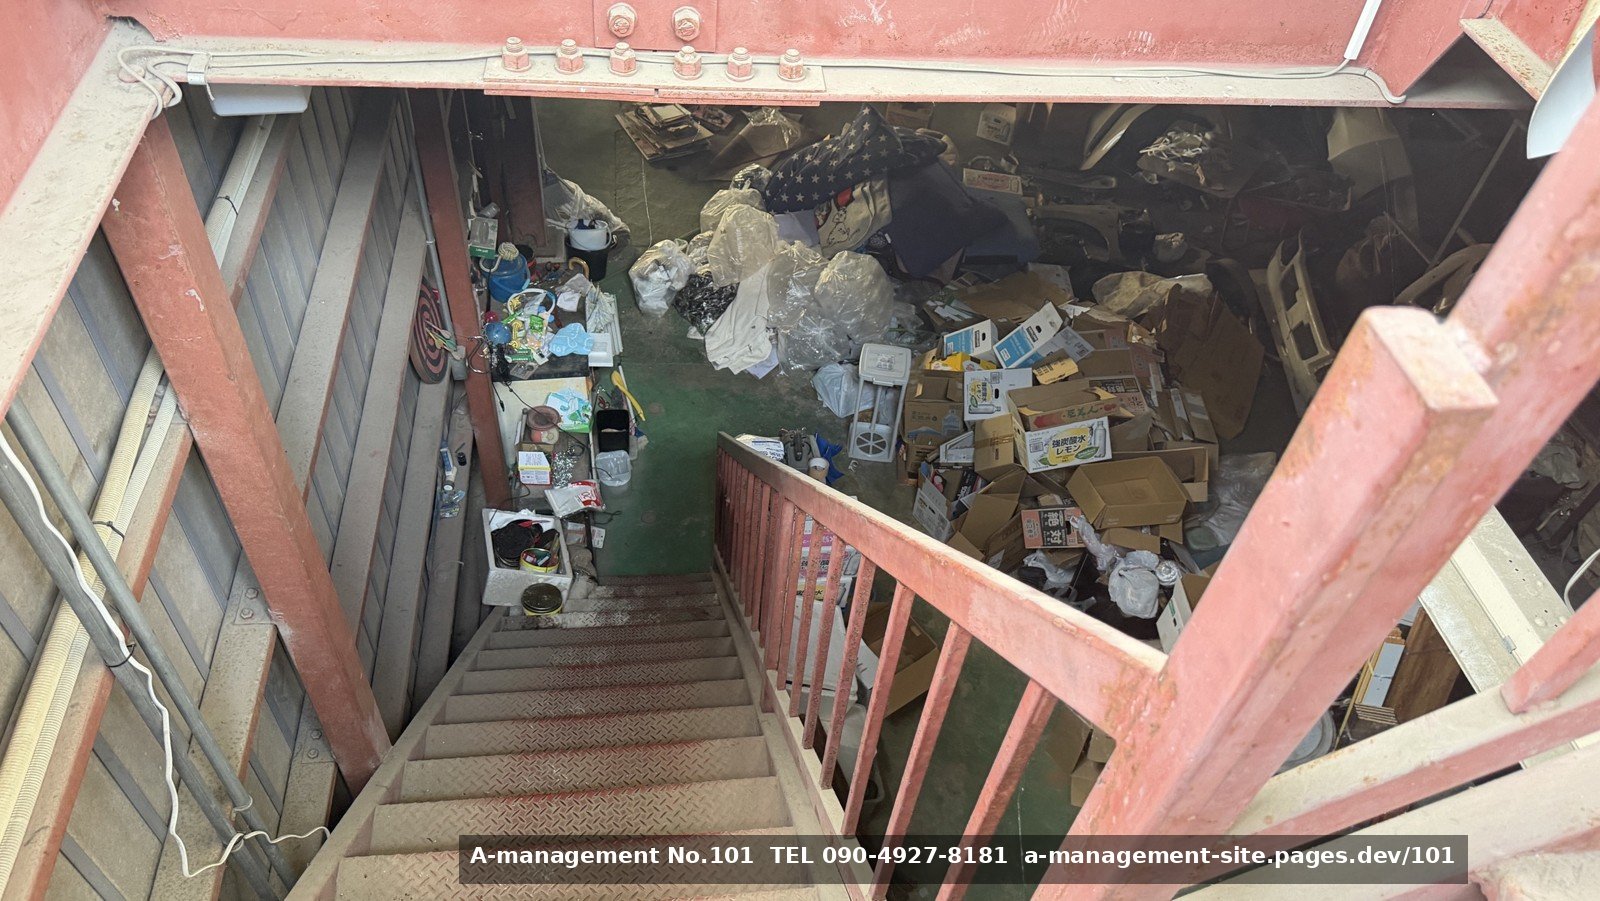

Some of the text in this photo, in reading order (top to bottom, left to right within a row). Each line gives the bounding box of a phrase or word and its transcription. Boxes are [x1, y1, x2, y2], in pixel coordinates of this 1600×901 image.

[1052, 434, 1086, 448] 強炭酸水
[1056, 444, 1081, 455] レモン
